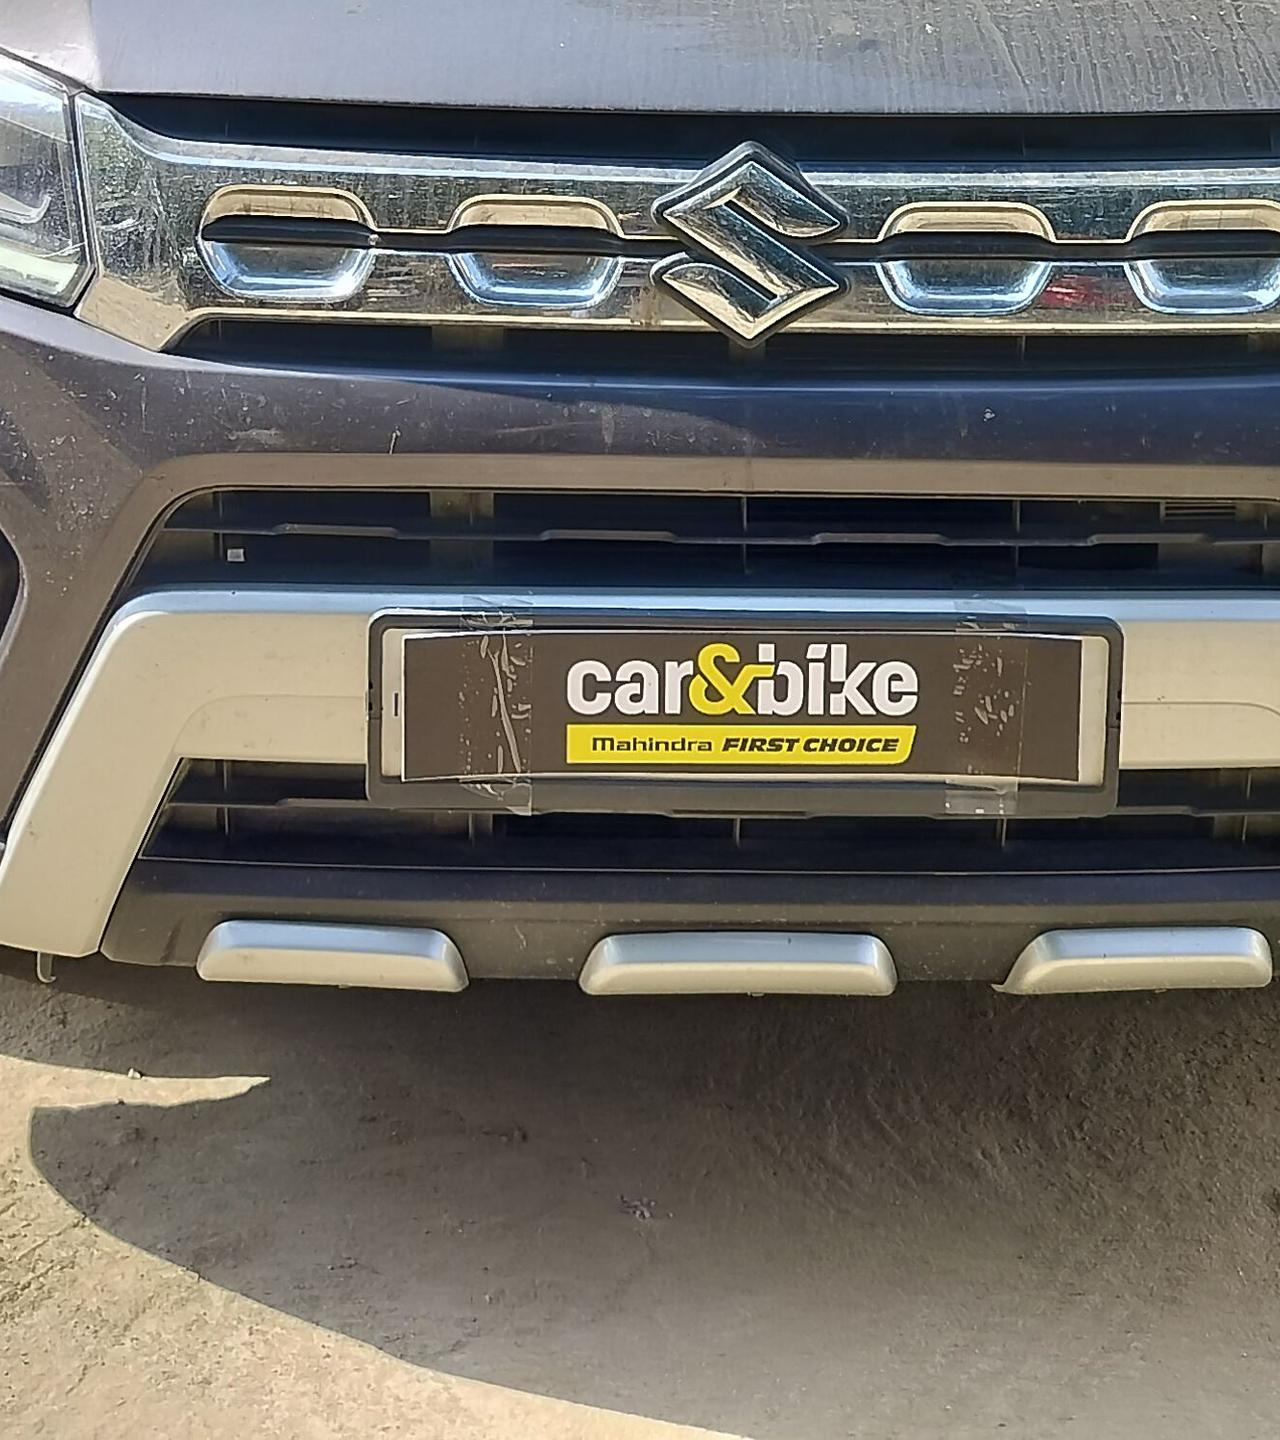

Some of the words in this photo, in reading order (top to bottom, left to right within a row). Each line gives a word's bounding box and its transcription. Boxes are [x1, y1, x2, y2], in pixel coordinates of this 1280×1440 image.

[566, 642, 919, 716] car&bike
[592, 736, 713, 752] Mahindra
[721, 737, 800, 752] FIRST
[802, 737, 900, 752] CHOICE
